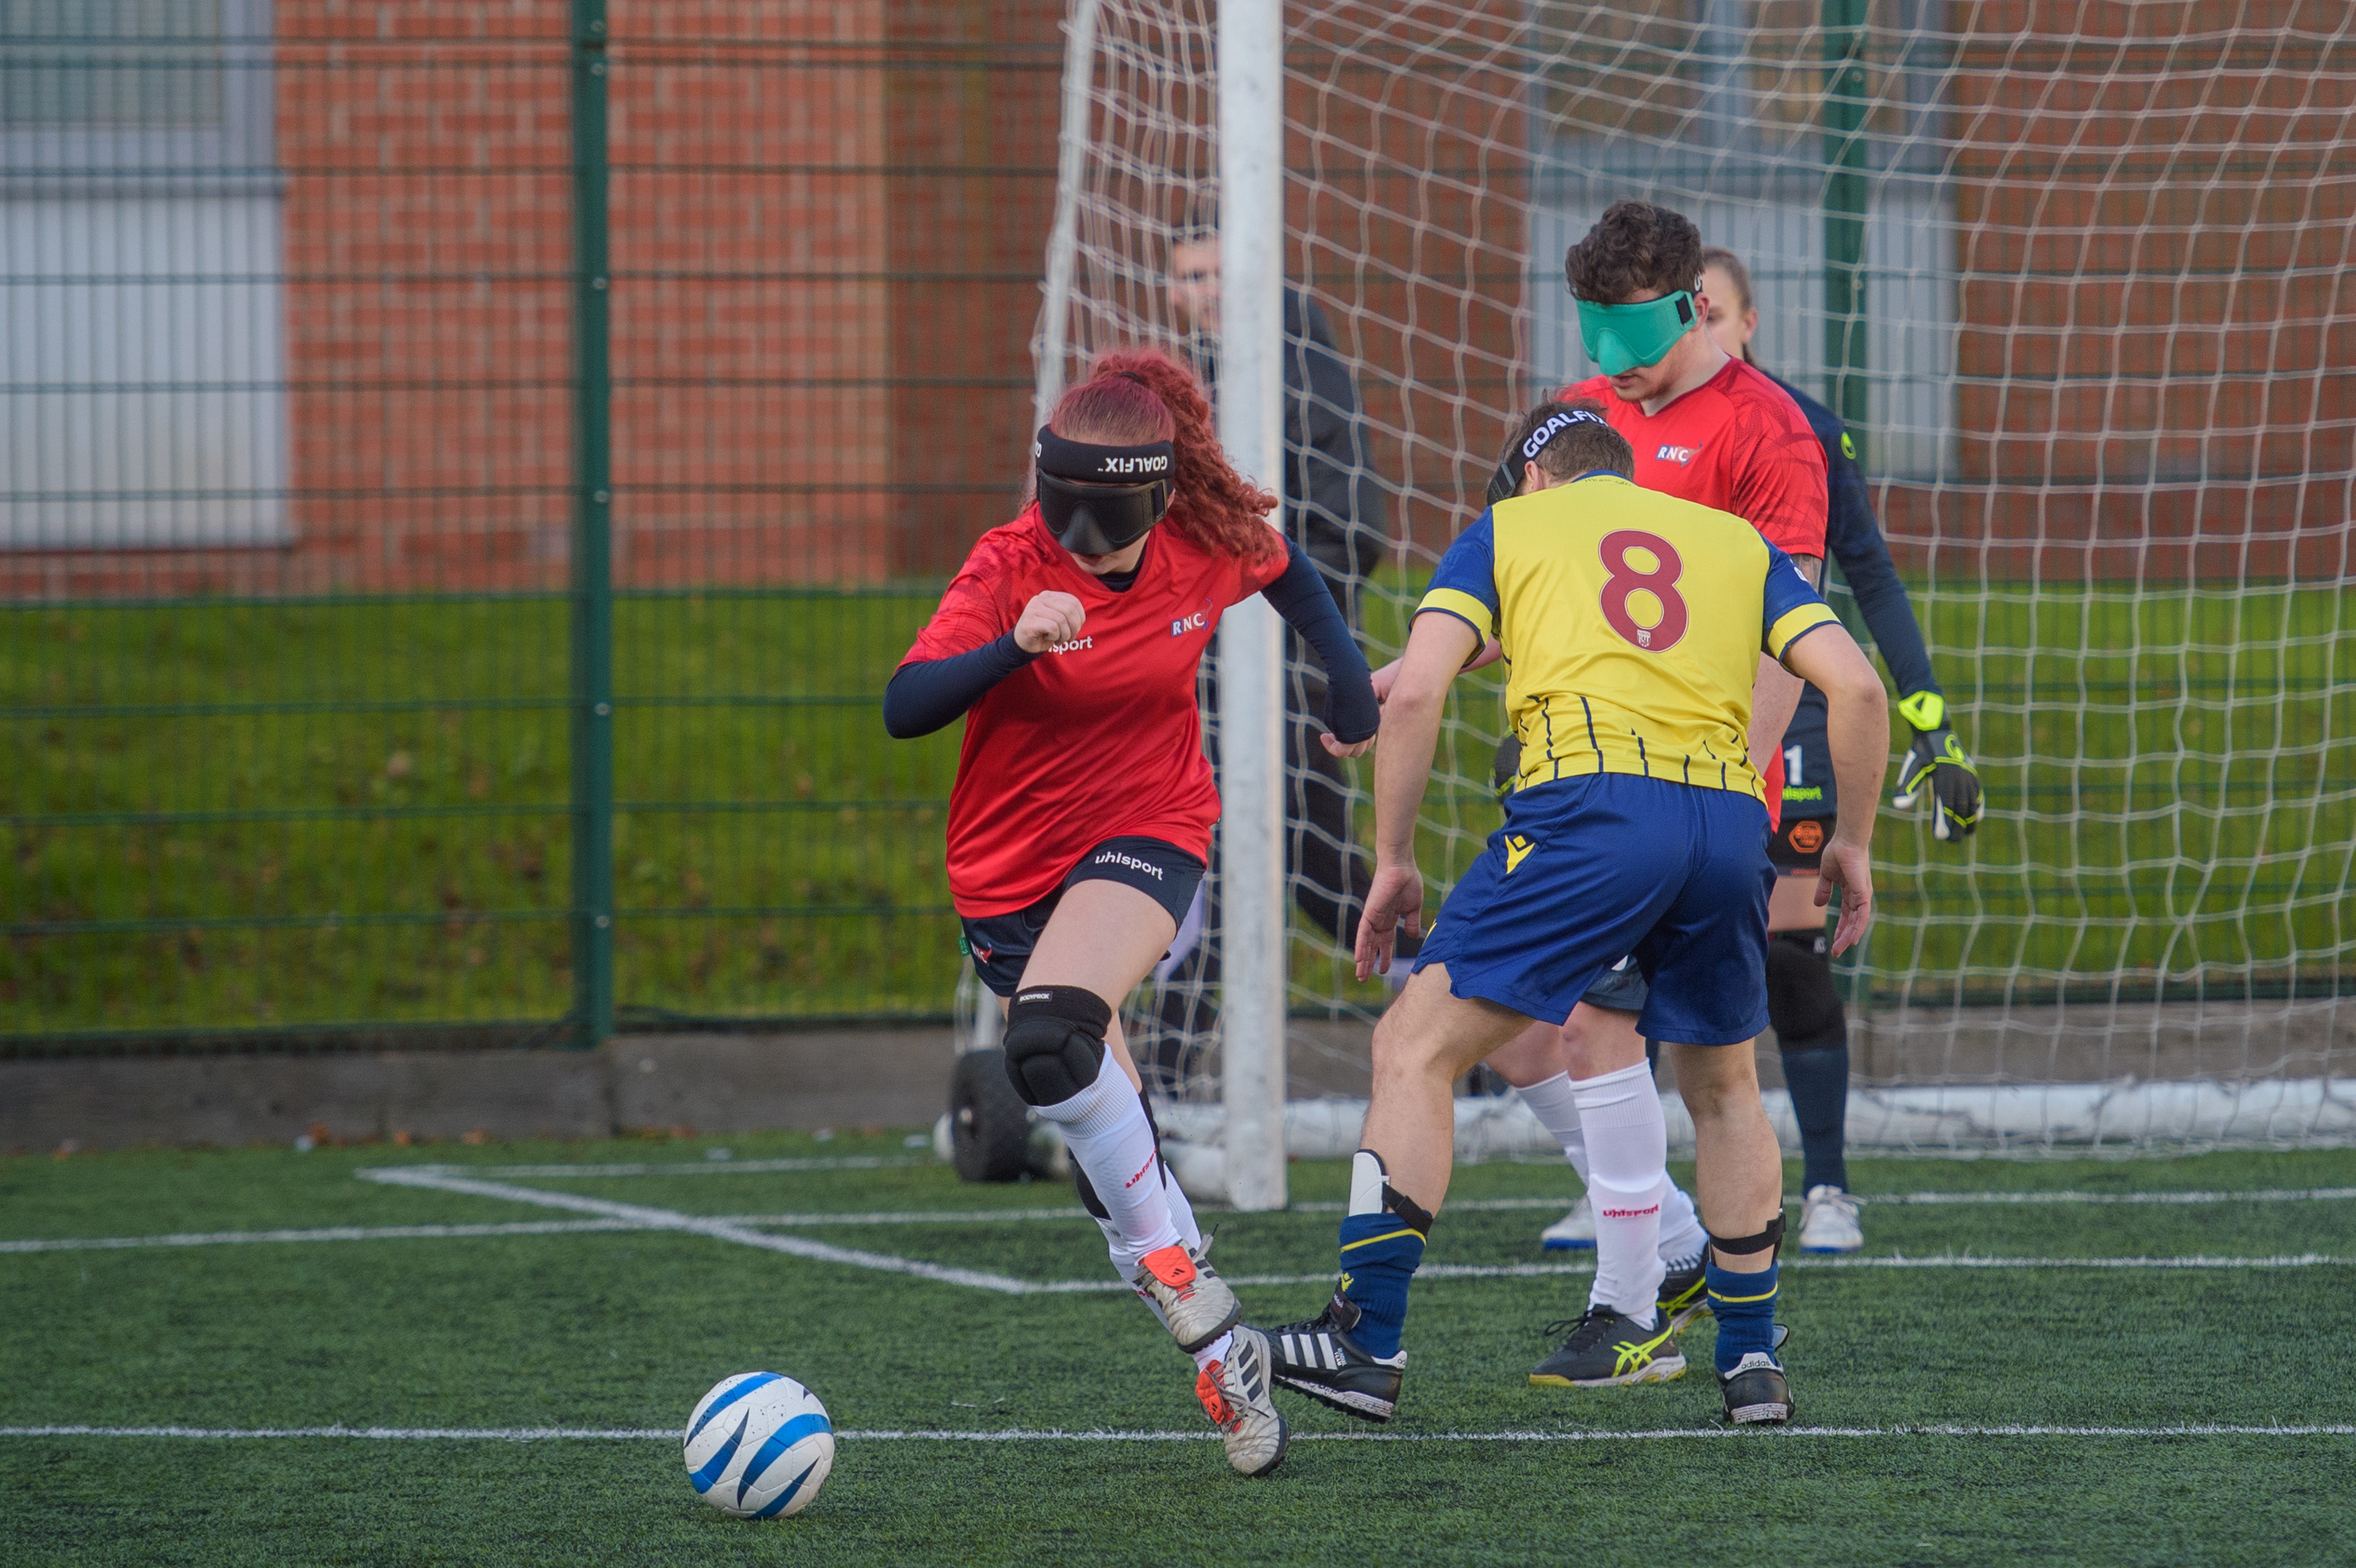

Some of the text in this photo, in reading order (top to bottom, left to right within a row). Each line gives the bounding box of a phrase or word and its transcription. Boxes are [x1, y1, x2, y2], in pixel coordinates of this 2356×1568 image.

[1657, 446, 1689, 462] RNC
[1598, 528, 1689, 653] 8
[1172, 612, 1205, 635] RNC
[1784, 745, 1802, 785] 1
[1095, 851, 1163, 881] uhlsport
[1602, 1204, 1658, 1217] uhlsport
[1741, 1360, 1770, 1369] adidas
